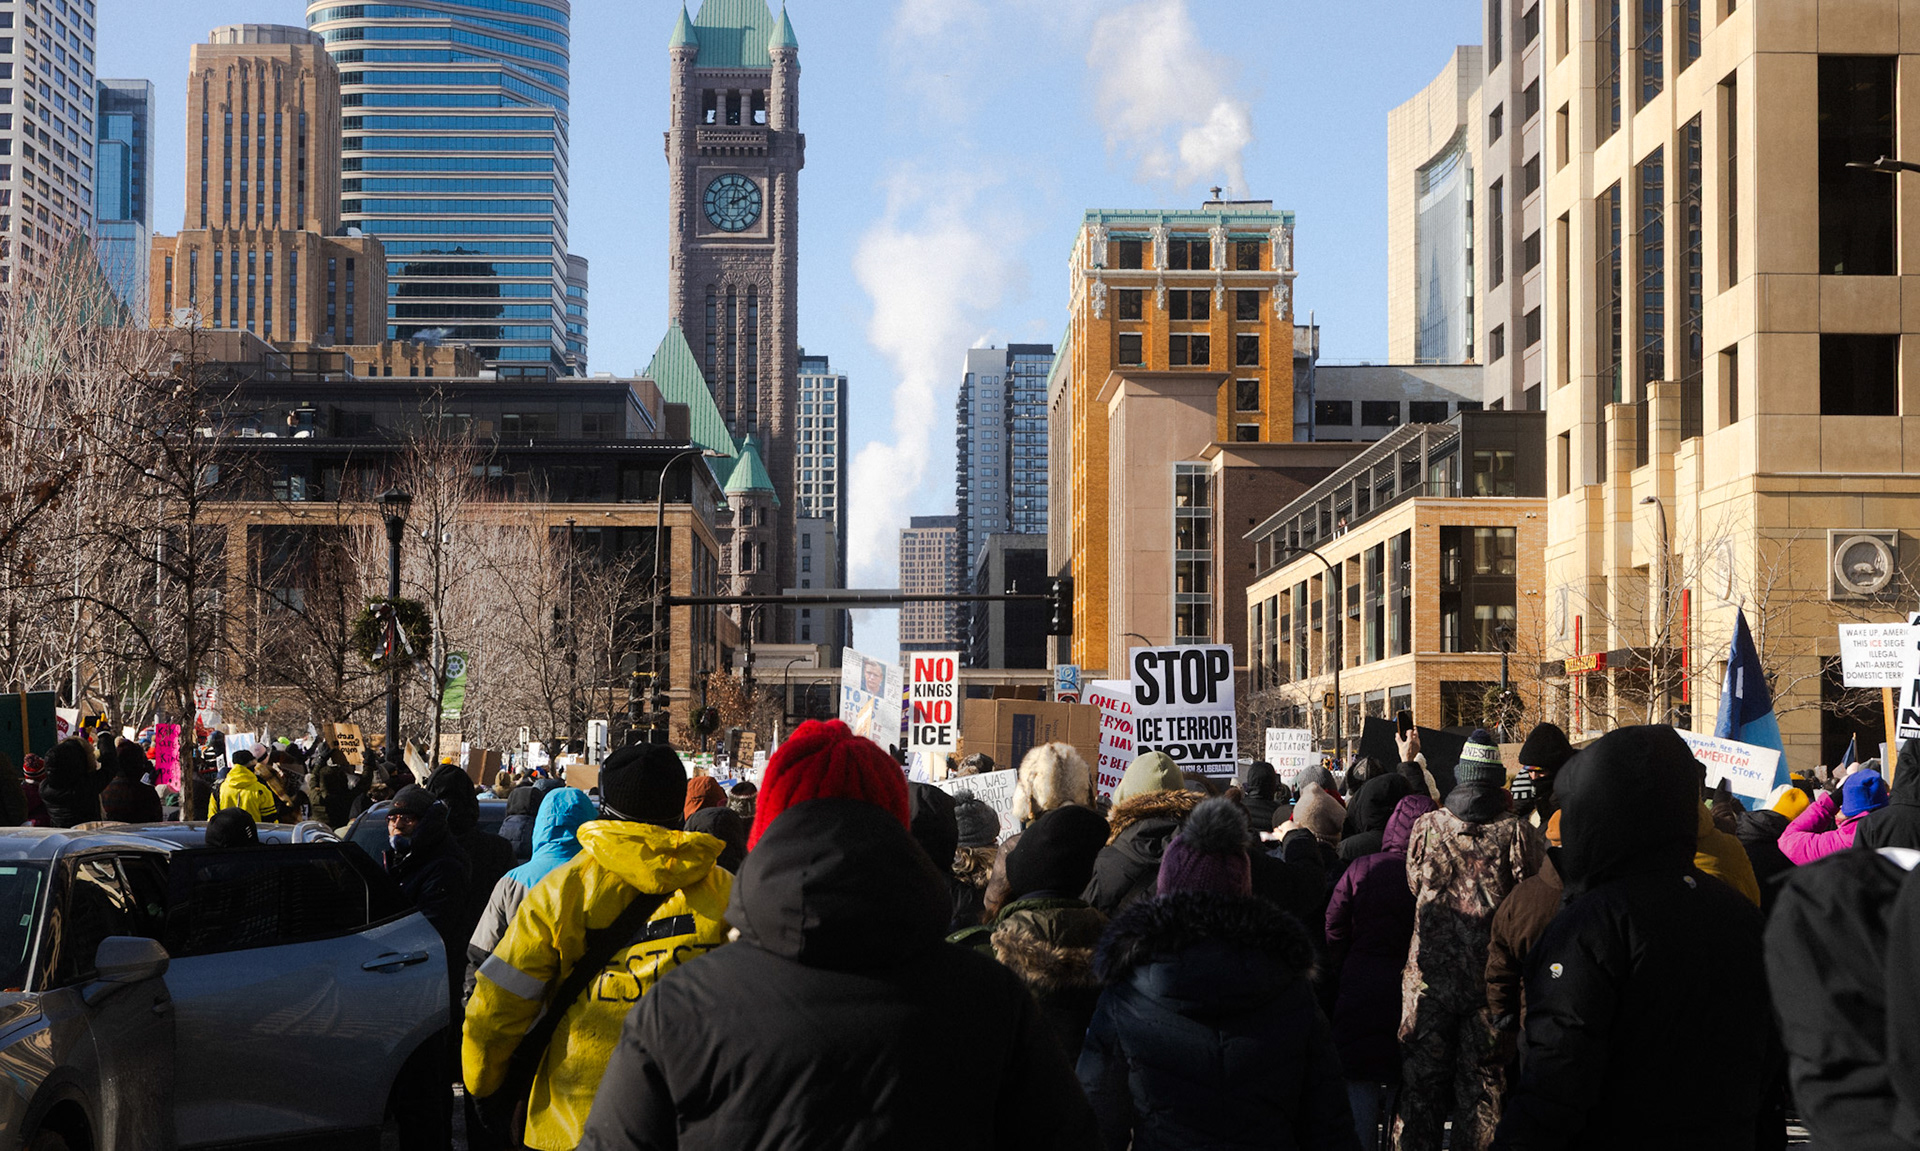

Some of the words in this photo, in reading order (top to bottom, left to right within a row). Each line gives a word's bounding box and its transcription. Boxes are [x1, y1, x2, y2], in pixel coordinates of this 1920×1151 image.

[1846, 629, 1867, 637] WAKE
[1853, 639, 1868, 647] THIS
[1869, 639, 1882, 647] ICE
[1883, 639, 1905, 647] SIEGE
[1869, 650, 1898, 658] ILLEGAL
[914, 658, 954, 683] NO
[1135, 650, 1230, 706] STOP
[1846, 671, 1884, 679] DOMESTIC
[196, 687, 216, 699] CE
[914, 683, 952, 698] KINGS
[913, 700, 952, 724] NO
[1089, 693, 1120, 711] ONE
[1121, 701, 1133, 715] D
[913, 725, 952, 746] ICE
[1136, 717, 1164, 743] ICE
[1165, 715, 1233, 741] TERROR
[1109, 735, 1134, 752] HAV
[1137, 743, 1234, 761] NOW!
[1719, 743, 1733, 753] are
[1735, 746, 1751, 757] the
[1280, 757, 1305, 766] RESIST
[1694, 748, 1750, 767] AMERICAN
[1203, 763, 1234, 774] LIBERATION
[1731, 765, 1764, 781] STORY.
[948, 777, 979, 797] THIS
[984, 772, 1008, 789] WAS
[976, 785, 1008, 803] ABOUT
